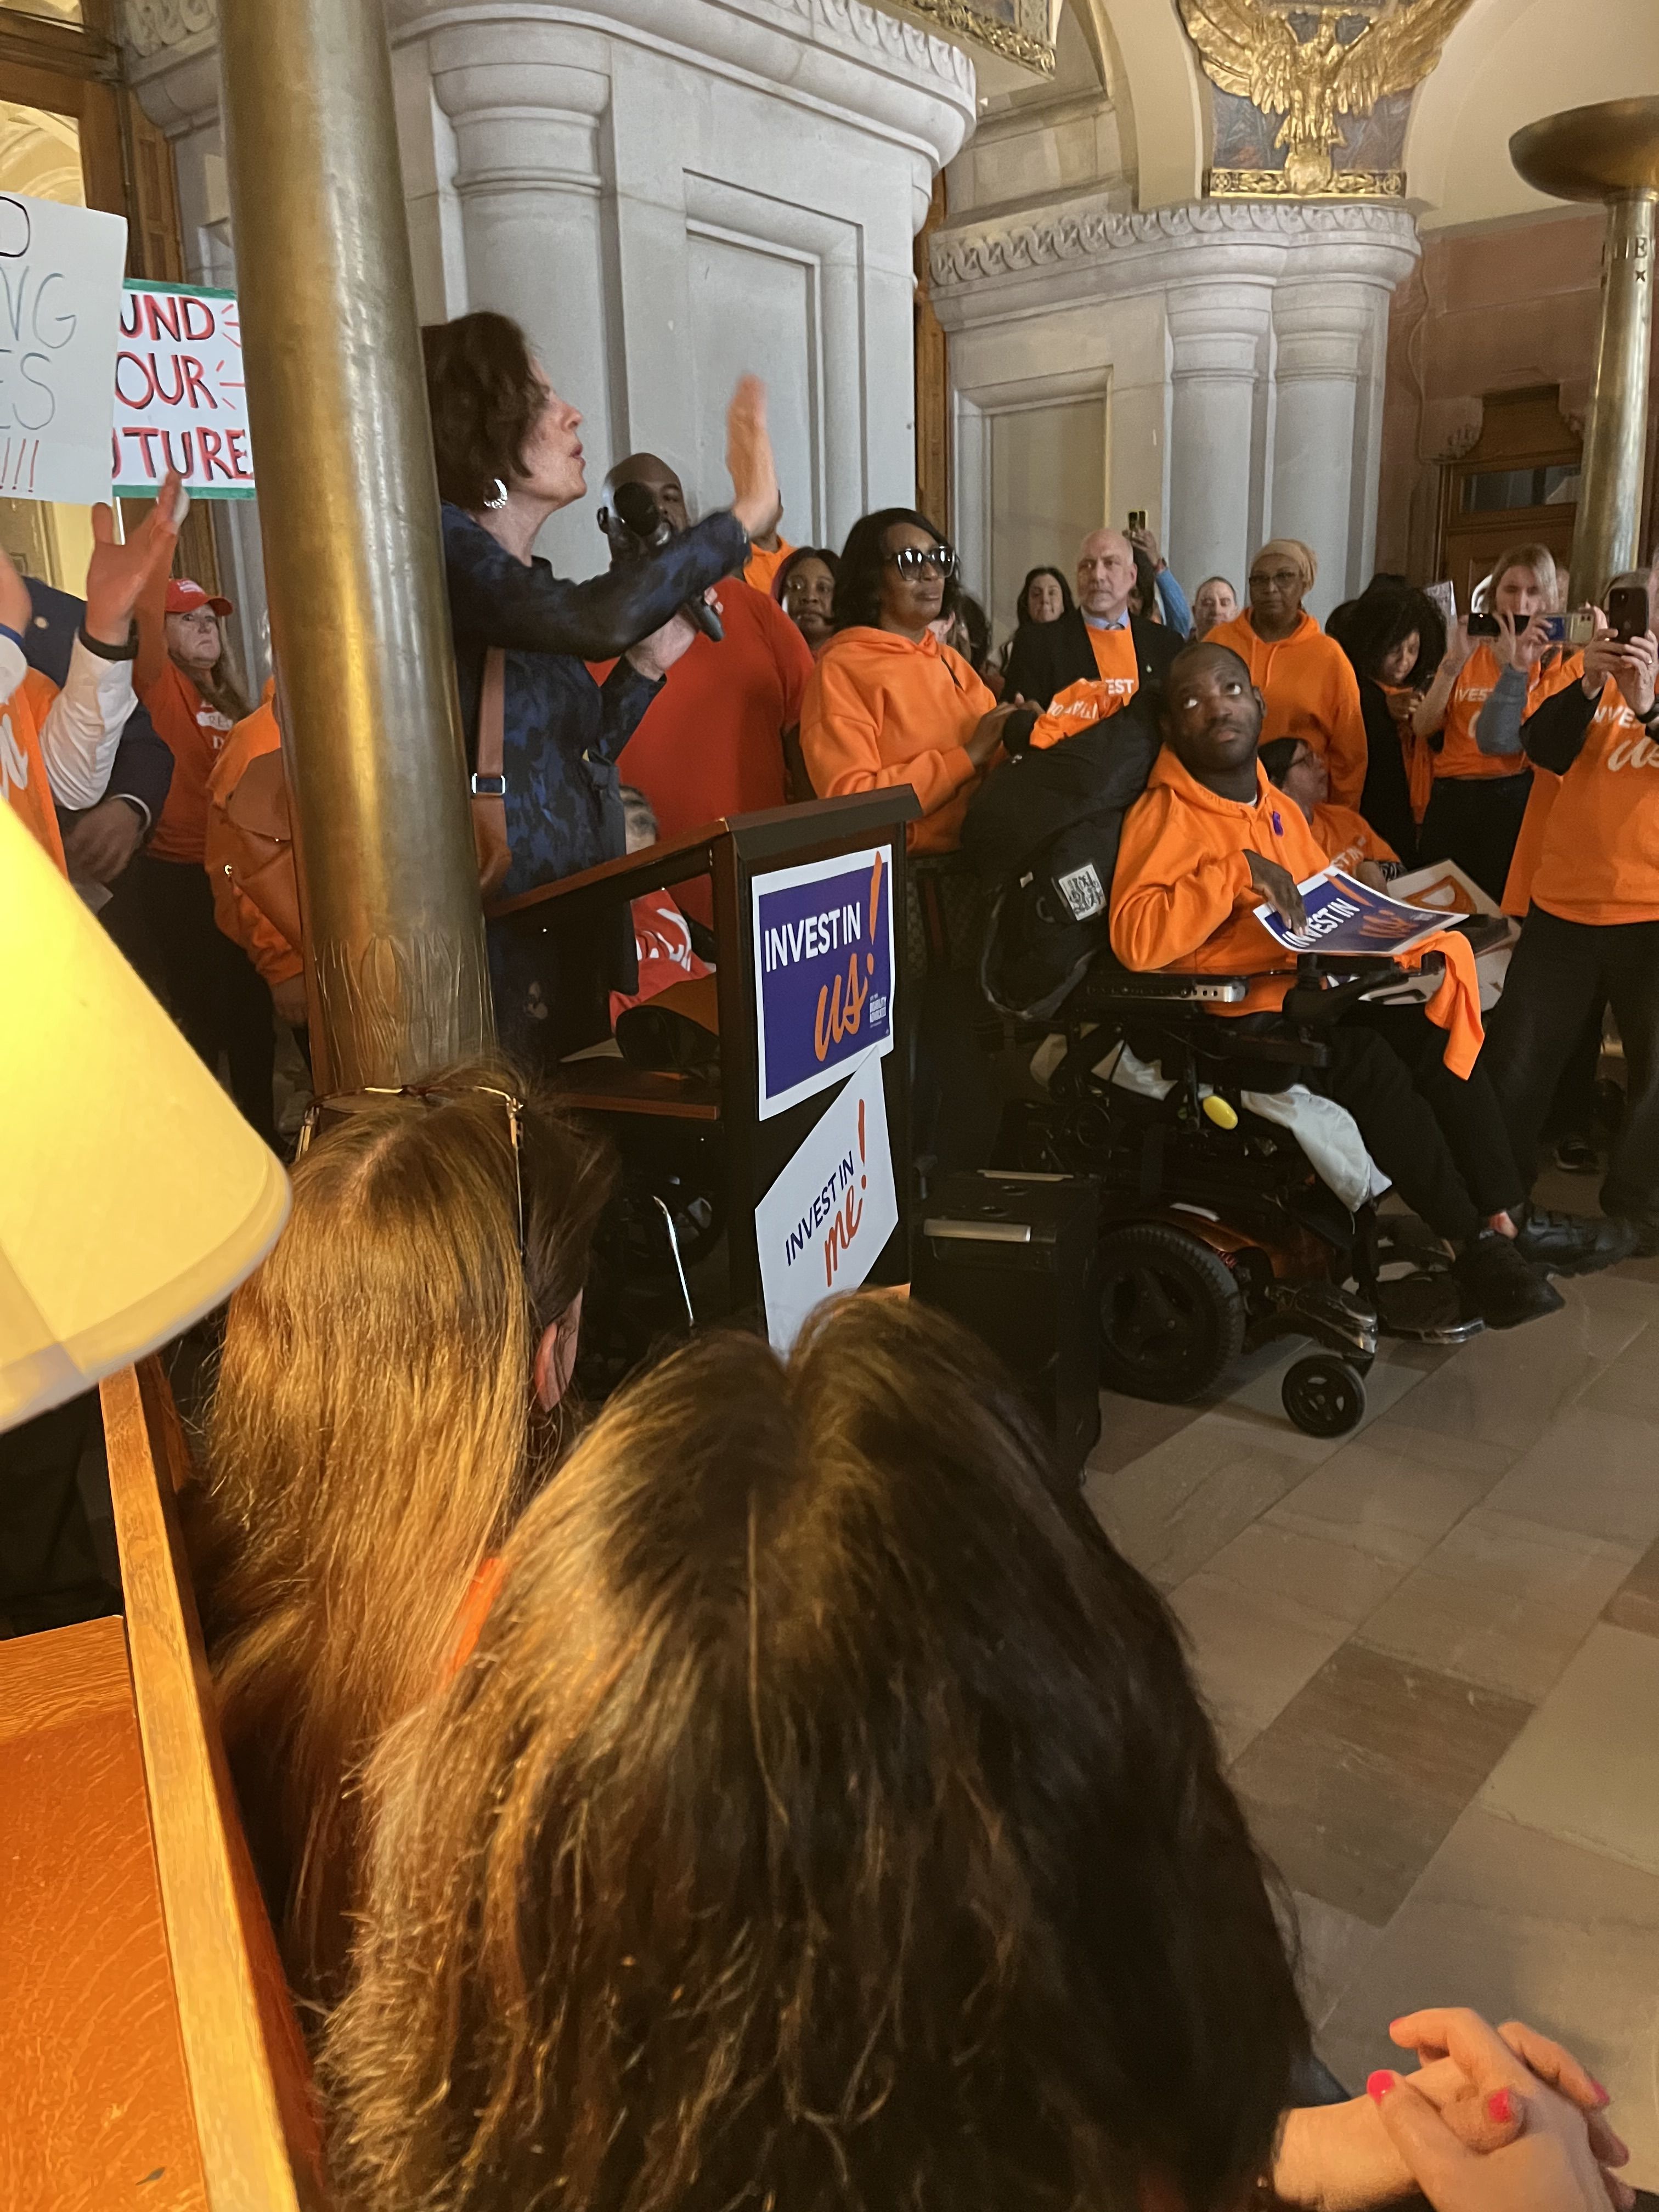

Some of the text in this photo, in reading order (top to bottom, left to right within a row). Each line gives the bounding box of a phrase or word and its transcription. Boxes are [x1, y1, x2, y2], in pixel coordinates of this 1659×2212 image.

[115, 351, 218, 410] OUR
[765, 901, 861, 973] INVEST IN
[1327, 898, 1361, 918] IN
[786, 1150, 854, 1267] INVEST IN
